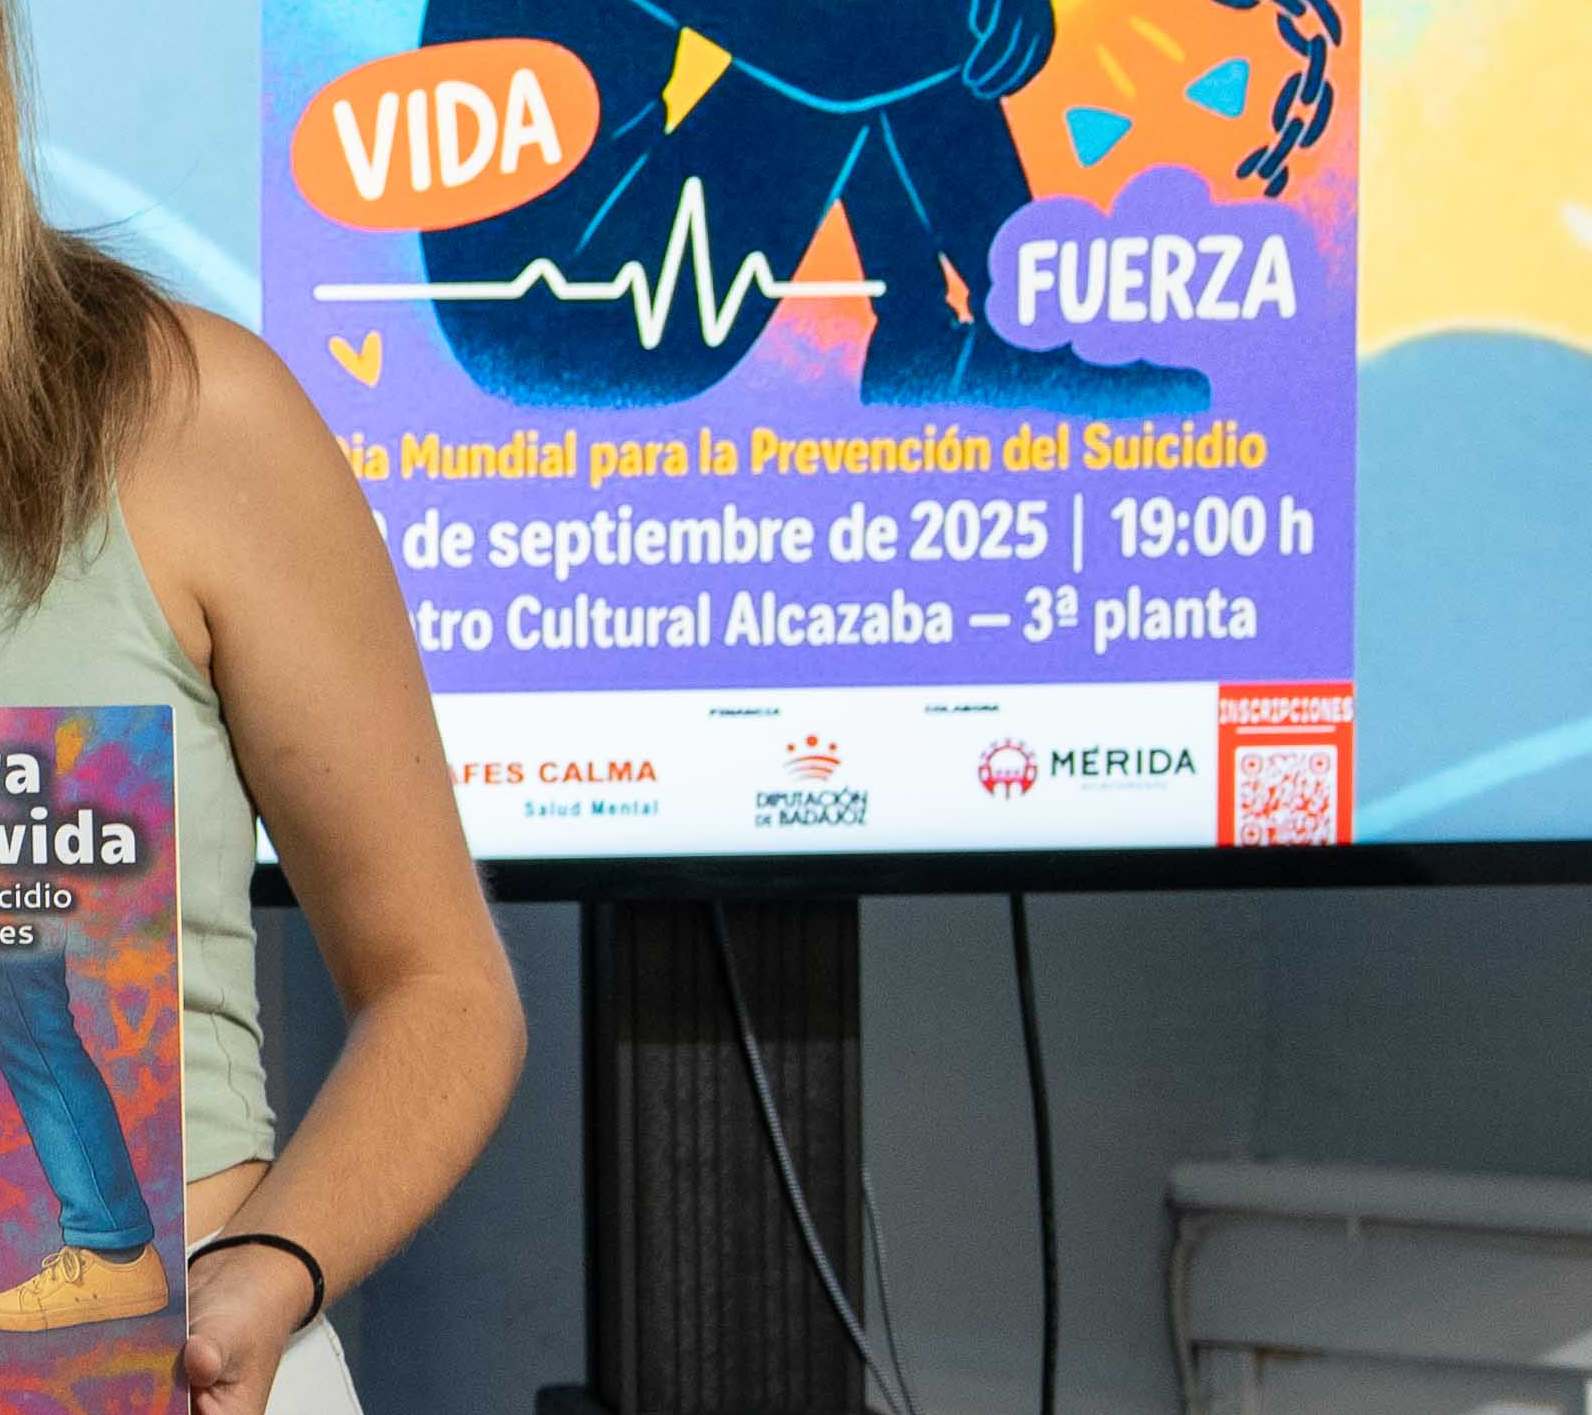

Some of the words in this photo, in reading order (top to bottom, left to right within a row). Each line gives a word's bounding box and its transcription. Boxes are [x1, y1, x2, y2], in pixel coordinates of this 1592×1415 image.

[332, 68, 562, 201] VIDA
[1017, 234, 1296, 325] FUERZA
[401, 429, 577, 479] Mundial
[590, 441, 688, 488] para
[700, 427, 738, 477] la
[751, 423, 991, 474] Prevención
[1003, 423, 1069, 470] del
[1083, 420, 1267, 469] Suicidio
[403, 507, 475, 568] de
[489, 503, 815, 581] septiembre
[829, 502, 898, 562] de
[910, 499, 1048, 561] 2025
[1110, 496, 1266, 557] 19:00
[1280, 495, 1314, 555] h
[506, 592, 711, 650] Cultural
[724, 588, 953, 647] Alcazaba
[1022, 585, 1080, 642] 3ª
[1094, 585, 1257, 655] planta
[1219, 697, 1354, 724] INSCRIPCIONES
[539, 761, 658, 784] CALMA
[1051, 745, 1197, 776] MÉRIDA
[523, 799, 582, 818] Salud
[591, 798, 659, 817] Mental
